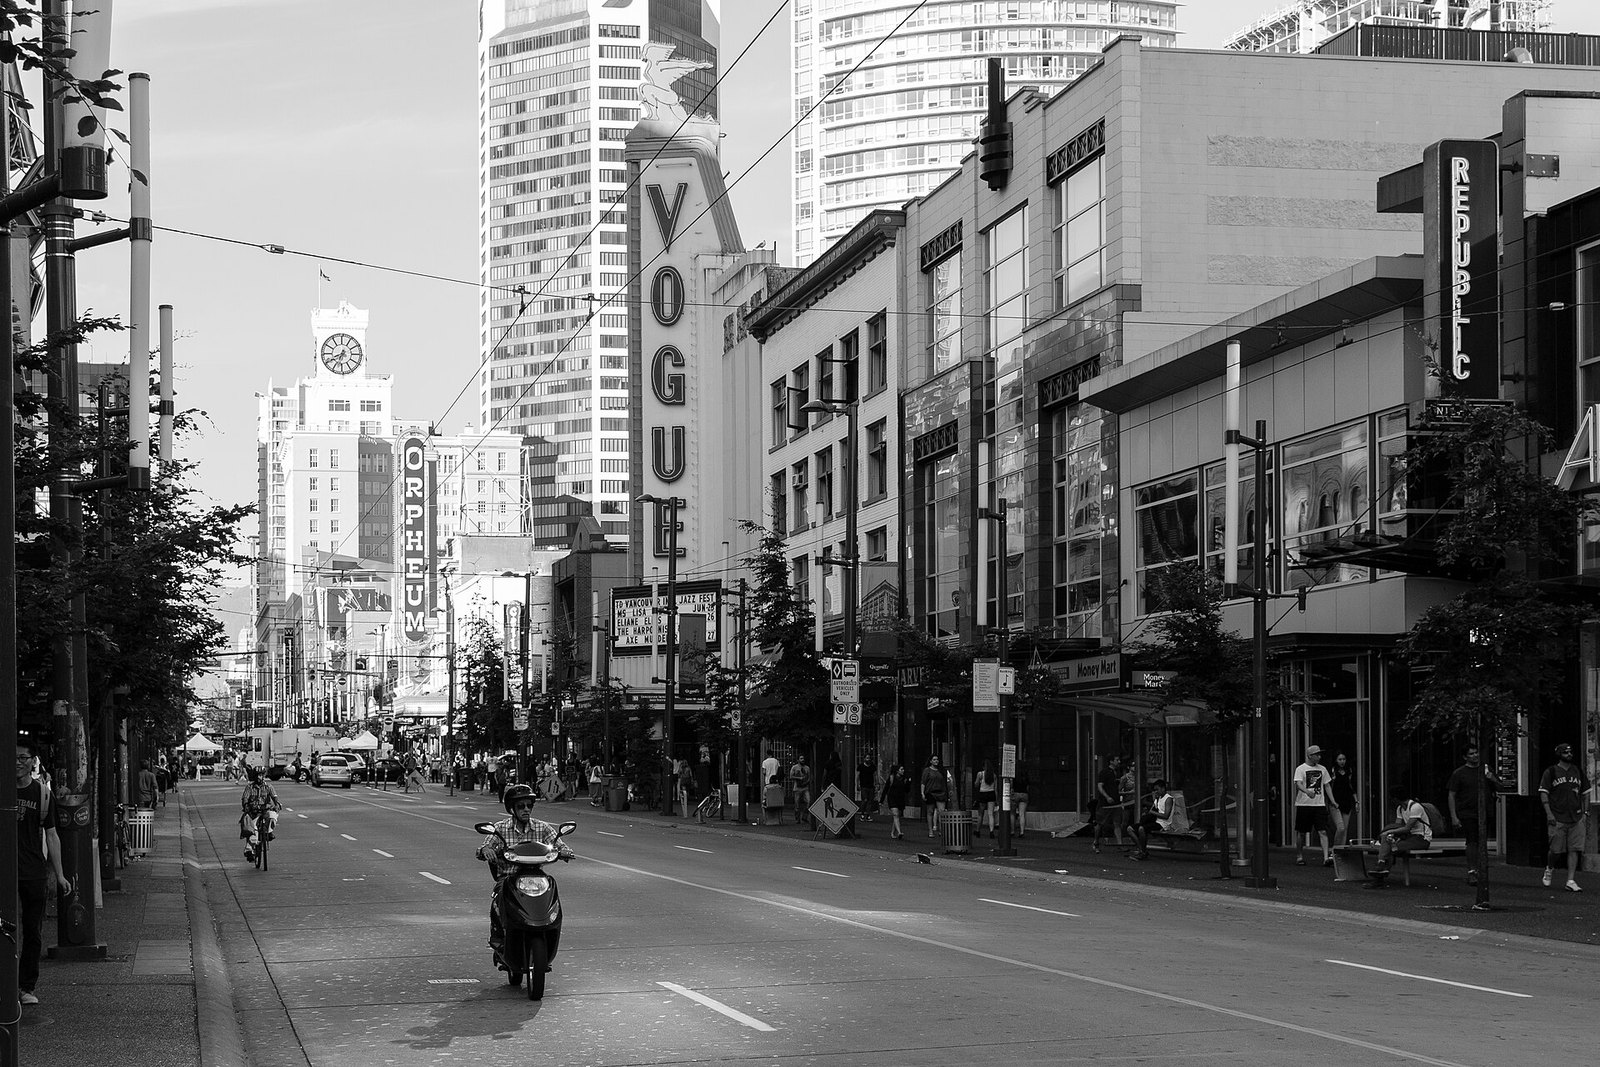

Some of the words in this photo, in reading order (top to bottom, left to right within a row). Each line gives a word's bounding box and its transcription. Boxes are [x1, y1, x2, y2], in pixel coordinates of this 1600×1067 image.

[1451, 156, 1471, 380] REPUBLIC
[645, 182, 688, 558] VOGUE
[405, 446, 424, 632] ORPHEUM
[625, 598, 661, 608] VANCOUVR
[679, 594, 696, 604] JAZZ
[699, 593, 714, 603] FEST
[617, 609, 626, 618] MS
[632, 608, 647, 617] LISA
[617, 617, 639, 627] ELIANE
[644, 616, 662, 625] ELS
[707, 613, 715, 621] 26
[617, 627, 629, 636] THE
[625, 636, 638, 645] AXE
[707, 631, 715, 640] 27
[1077, 661, 1100, 679] Money
[1100, 659, 1117, 675] Mart
[1143, 673, 1165, 681] Money
[1144, 680, 1164, 688] Mart
[16, 798, 37, 810] TBALL
